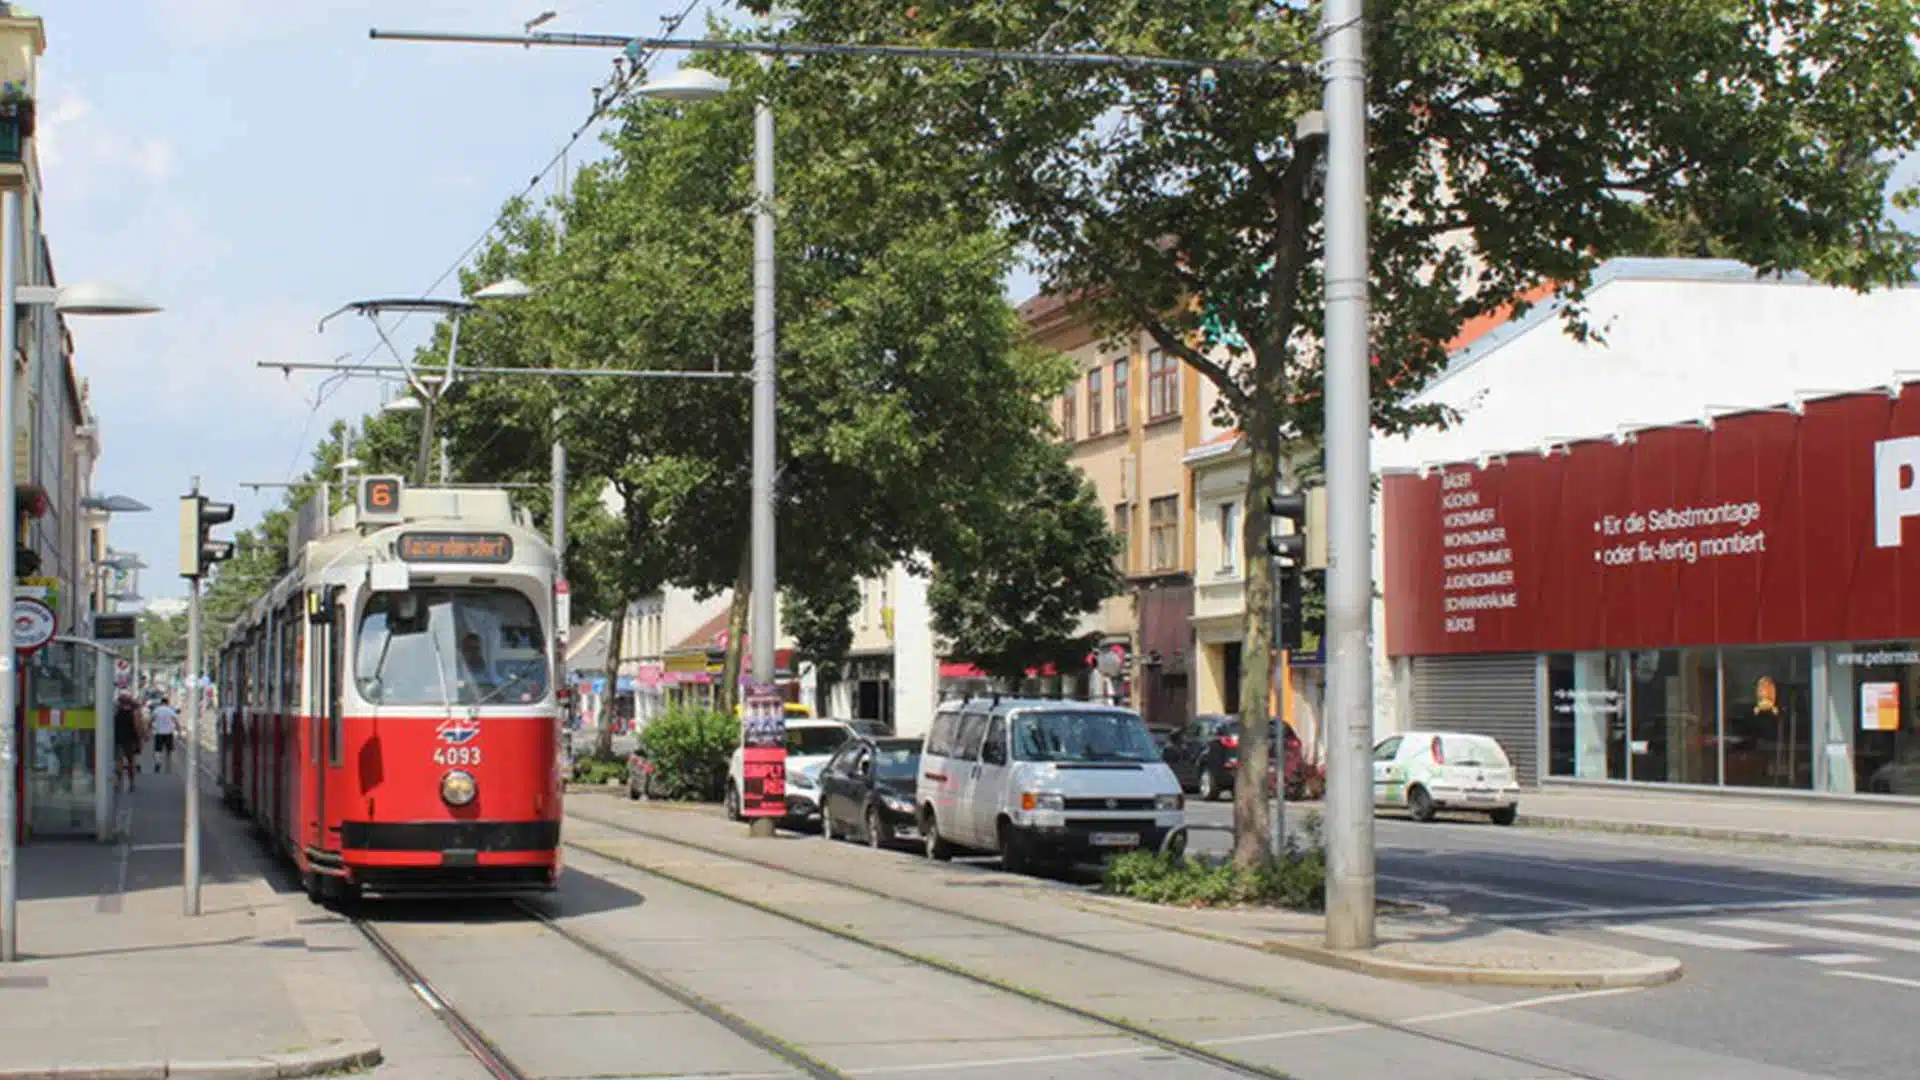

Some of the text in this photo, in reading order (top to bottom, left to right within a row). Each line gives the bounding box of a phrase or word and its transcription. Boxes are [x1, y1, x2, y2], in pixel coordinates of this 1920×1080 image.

[372, 483, 391, 507] 6
[1603, 502, 1760, 535] für die Selbstmontage
[1603, 530, 1765, 565] oder fix-fertig montiert
[433, 747, 480, 765] 4093
